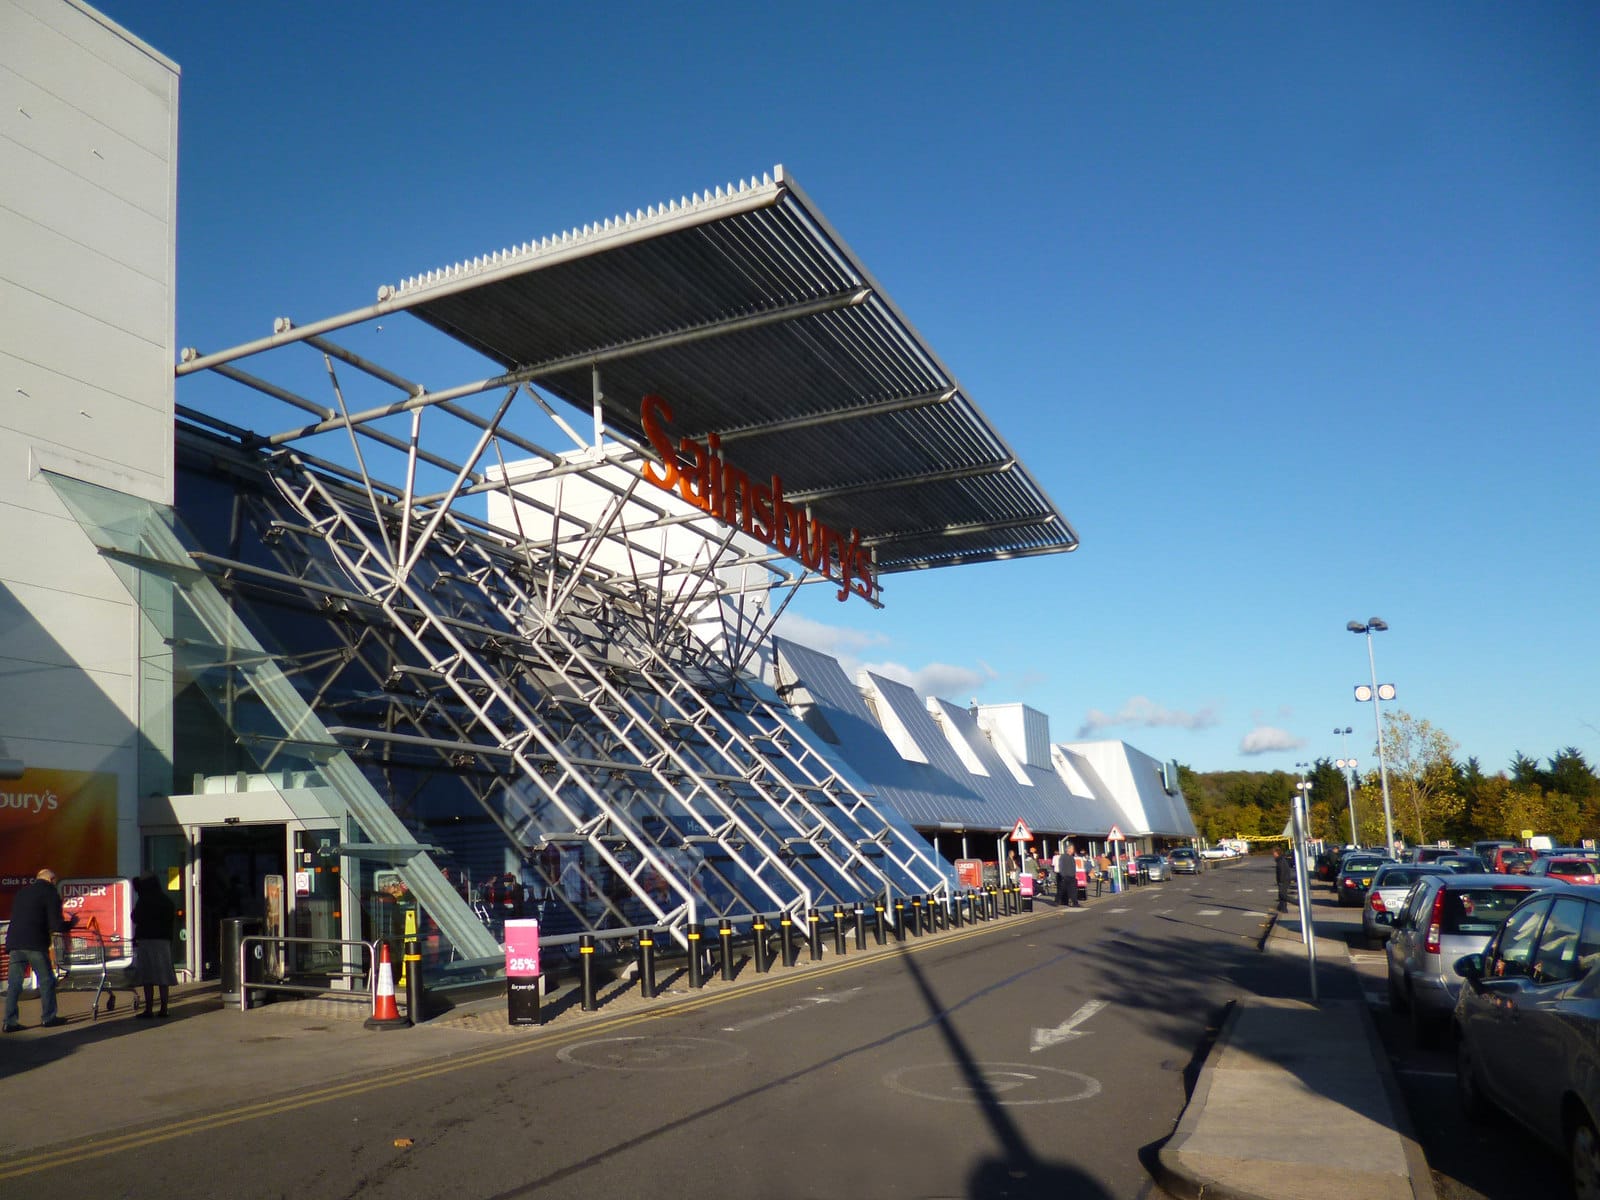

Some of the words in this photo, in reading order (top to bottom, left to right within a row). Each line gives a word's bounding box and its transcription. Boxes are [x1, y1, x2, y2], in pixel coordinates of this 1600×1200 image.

[641, 394, 873, 602] Sainsbury's
[63, 885, 107, 896] UNDER
[62, 897, 85, 908] 25?
[510, 958, 536, 970] 25%
